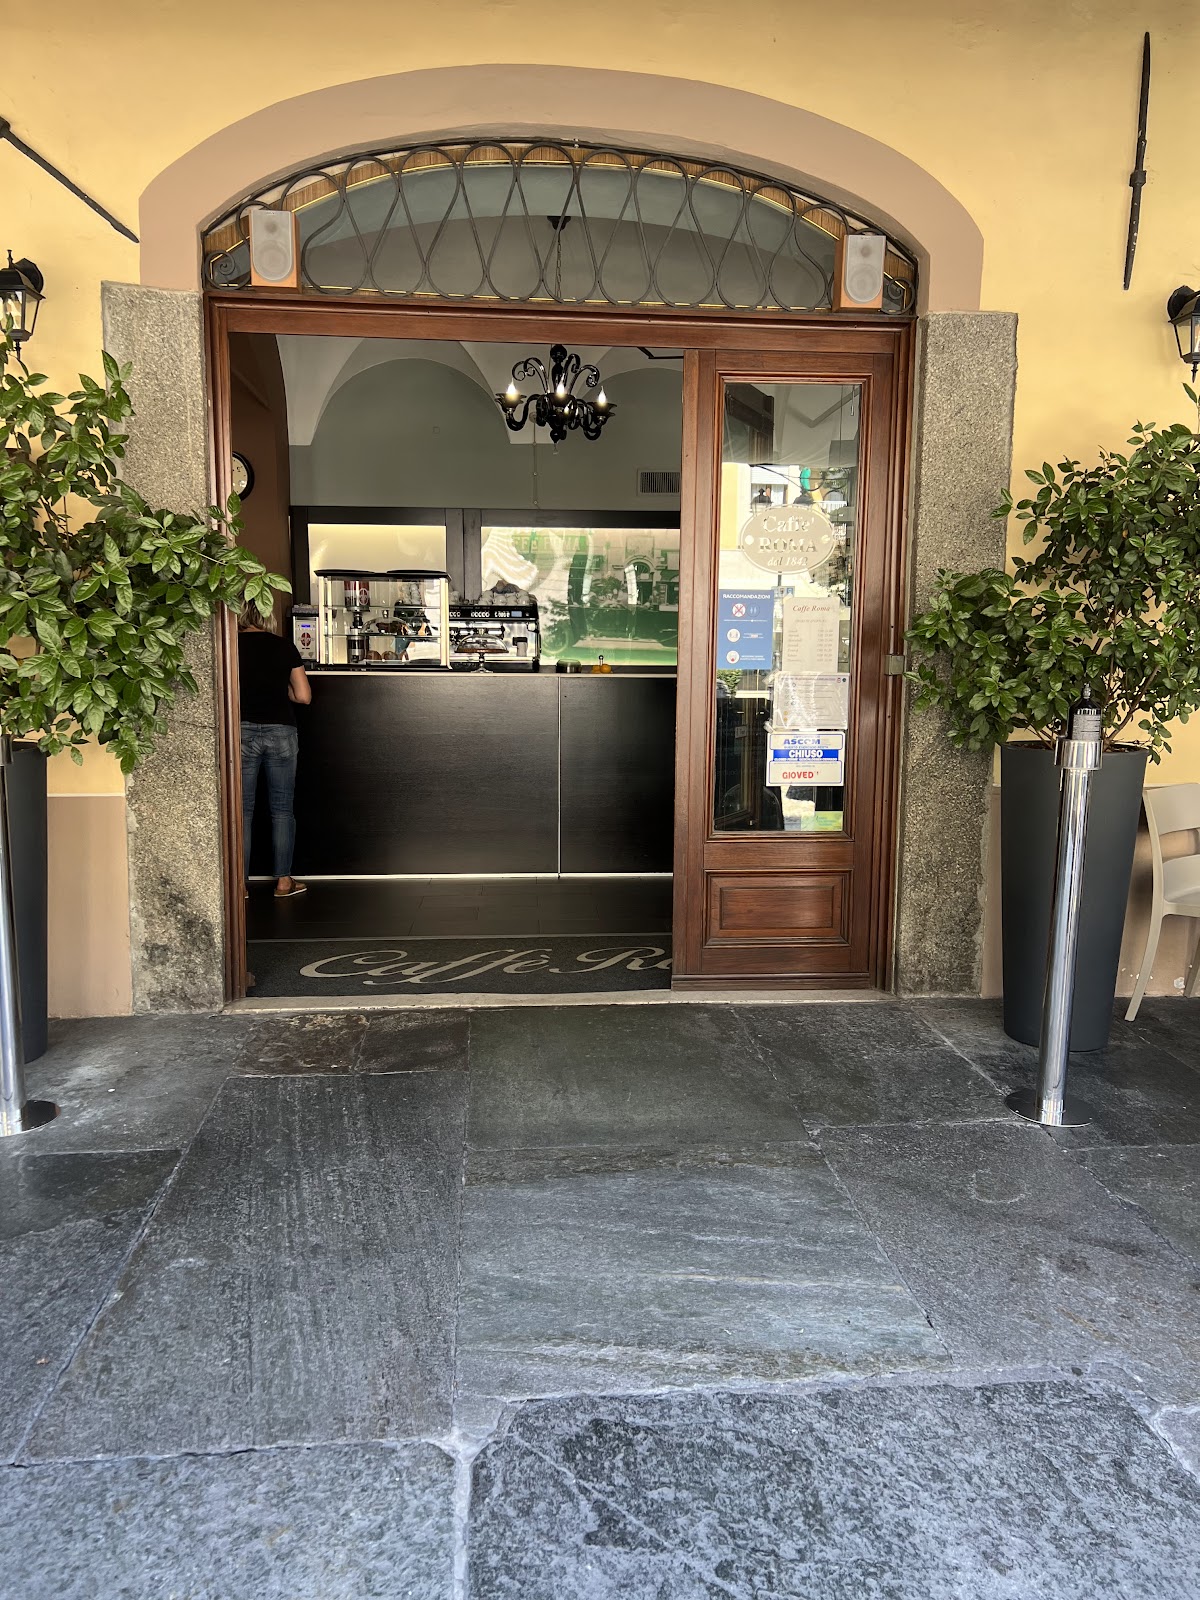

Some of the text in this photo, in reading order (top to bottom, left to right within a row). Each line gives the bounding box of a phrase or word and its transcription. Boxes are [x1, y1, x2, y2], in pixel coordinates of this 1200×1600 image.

[759, 538, 818, 553] ROMA
[767, 556, 809, 567] dal 1842
[788, 749, 824, 758] CHIUSO
[299, 947, 553, 986] Caffè
